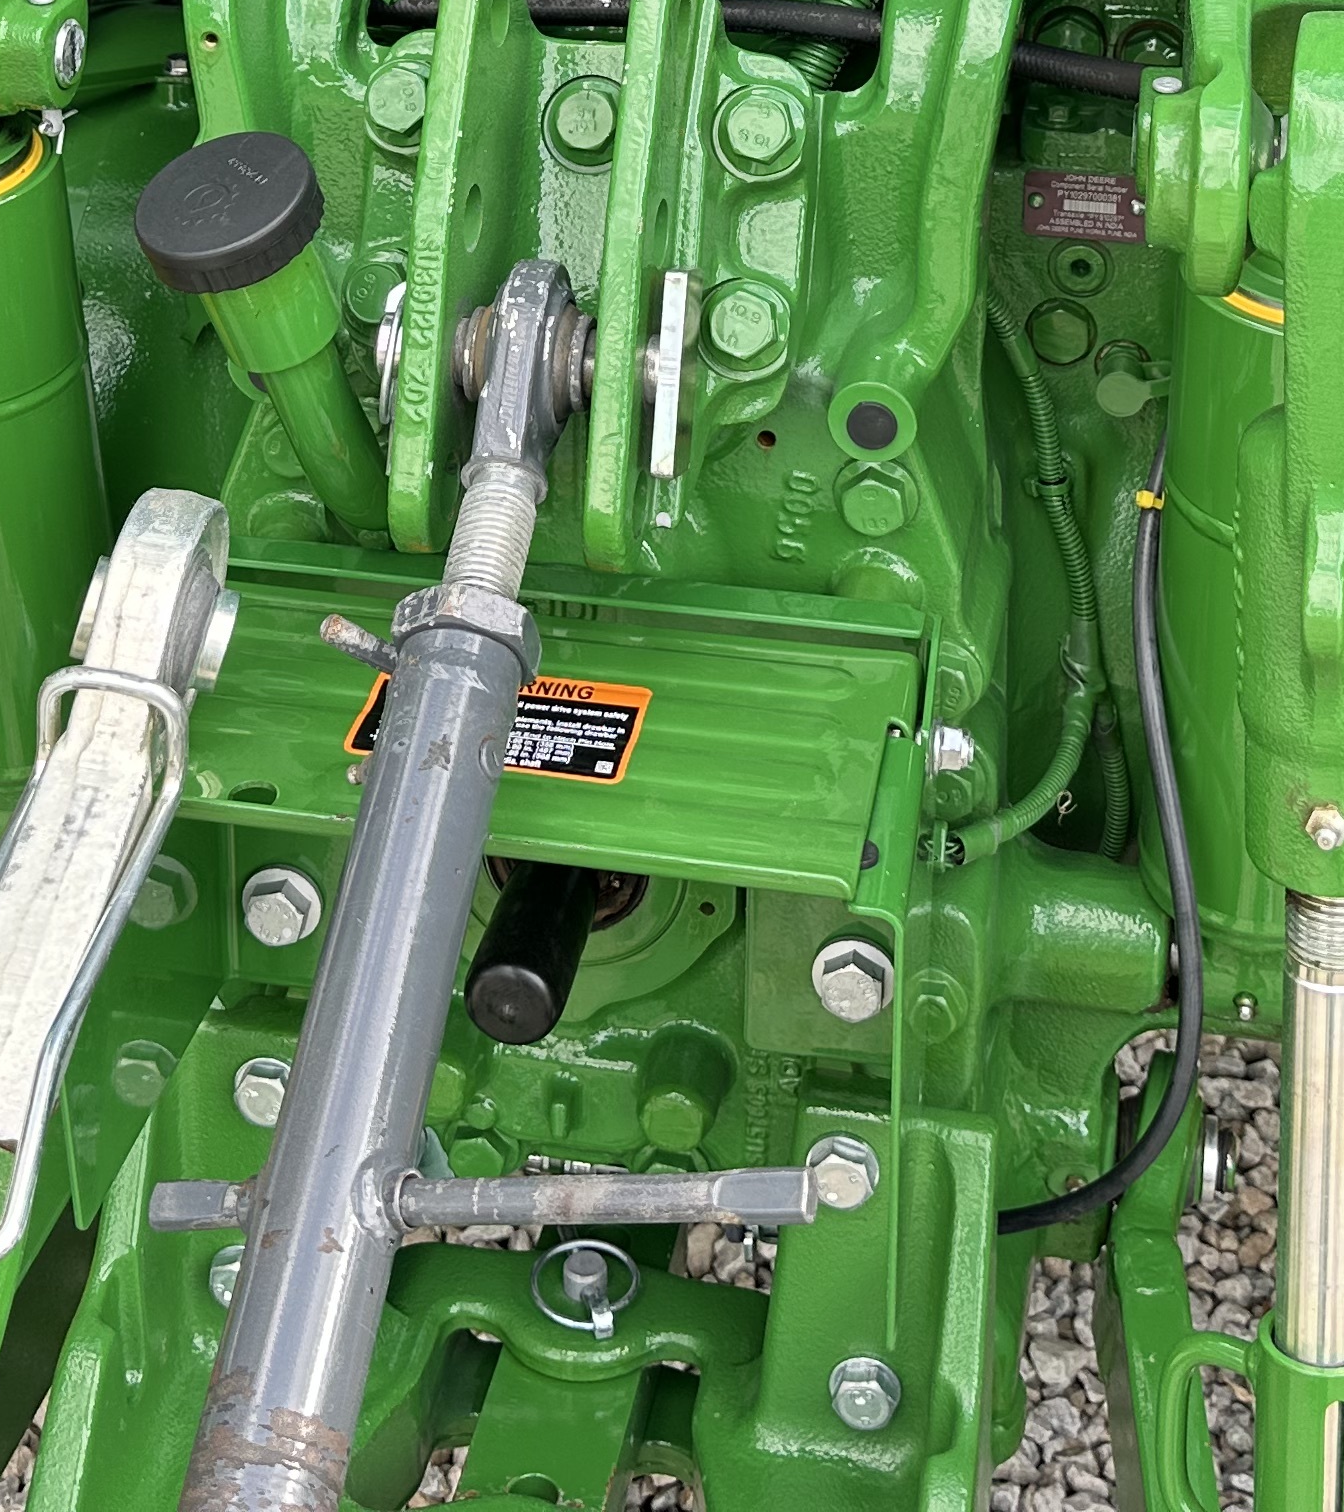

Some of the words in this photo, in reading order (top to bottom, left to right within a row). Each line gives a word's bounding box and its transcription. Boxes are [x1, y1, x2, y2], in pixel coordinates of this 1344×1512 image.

[1064, 174, 1086, 183] JOHN
[1087, 175, 1116, 185] DEERE
[518, 680, 595, 700] RNING
